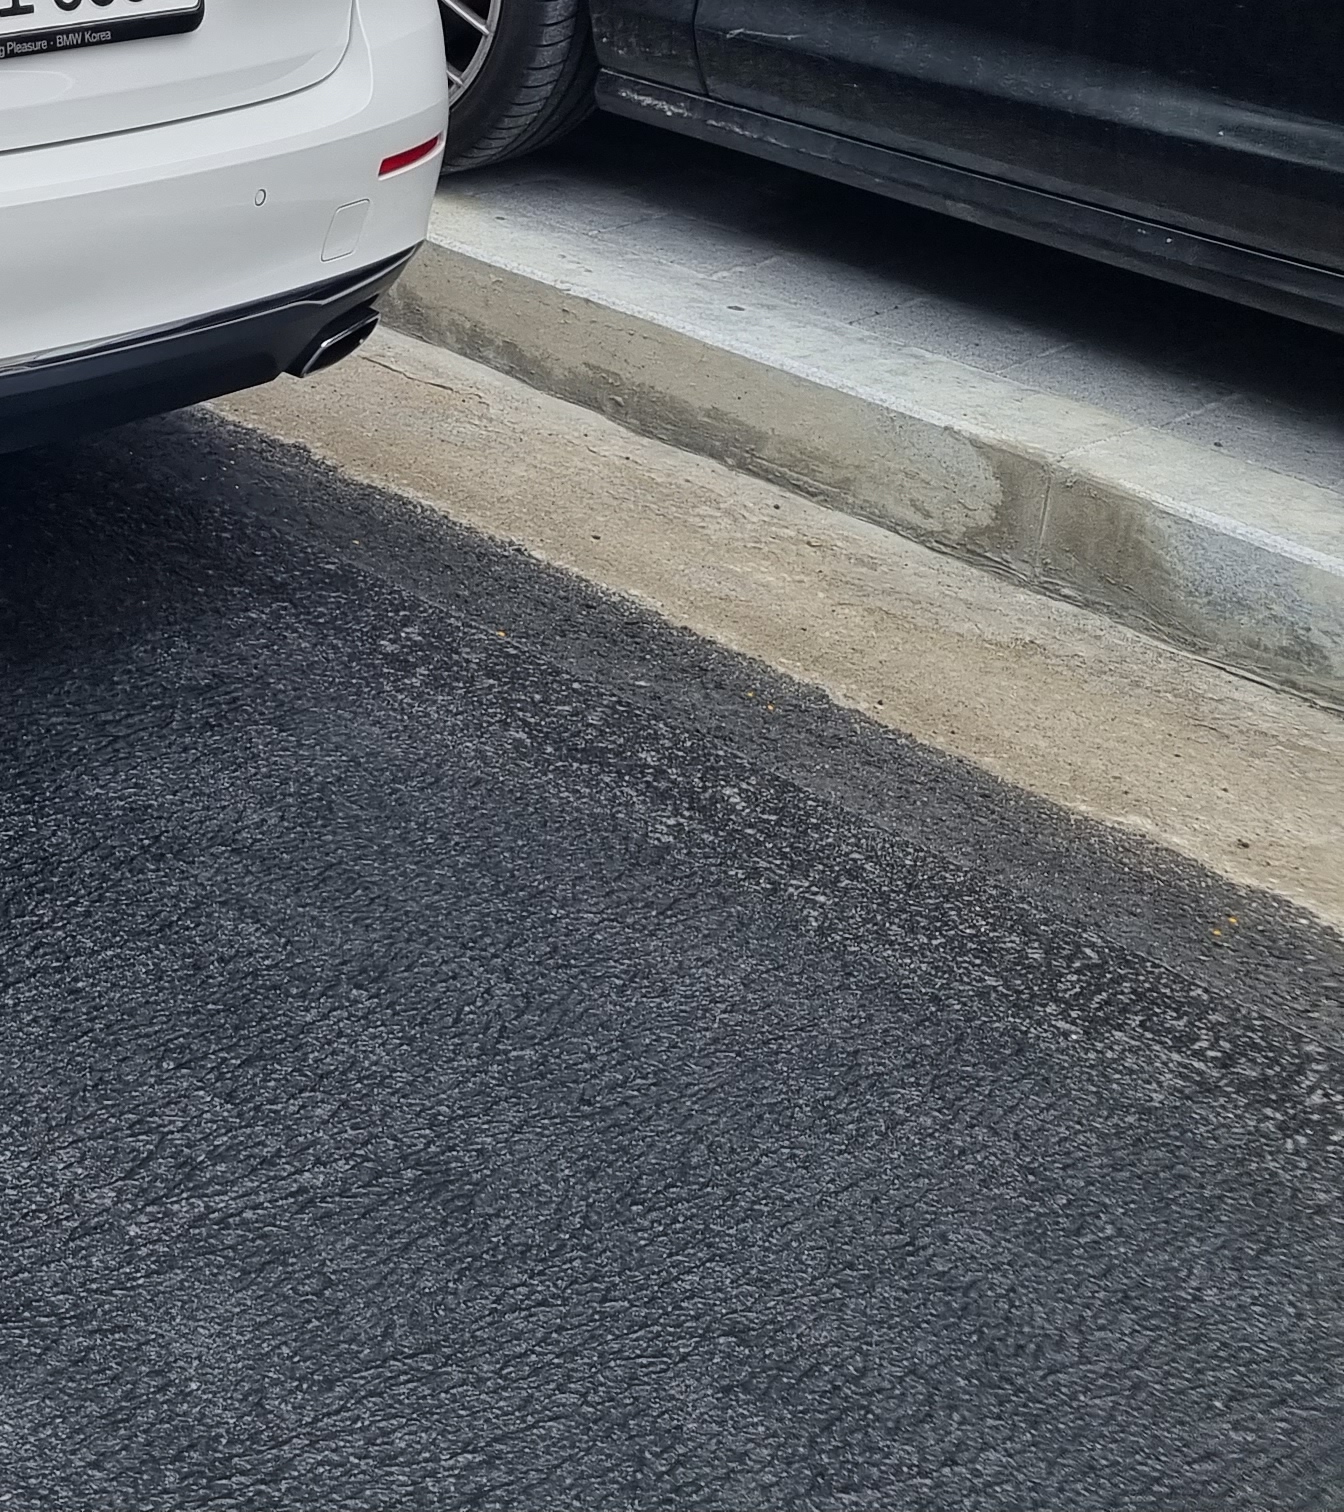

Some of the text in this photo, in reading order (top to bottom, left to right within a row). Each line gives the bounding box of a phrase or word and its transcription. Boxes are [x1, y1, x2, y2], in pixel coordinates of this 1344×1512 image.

[7, 38, 48, 55] Pleasure
[56, 33, 83, 48] BMW
[85, 29, 112, 43] Korea
